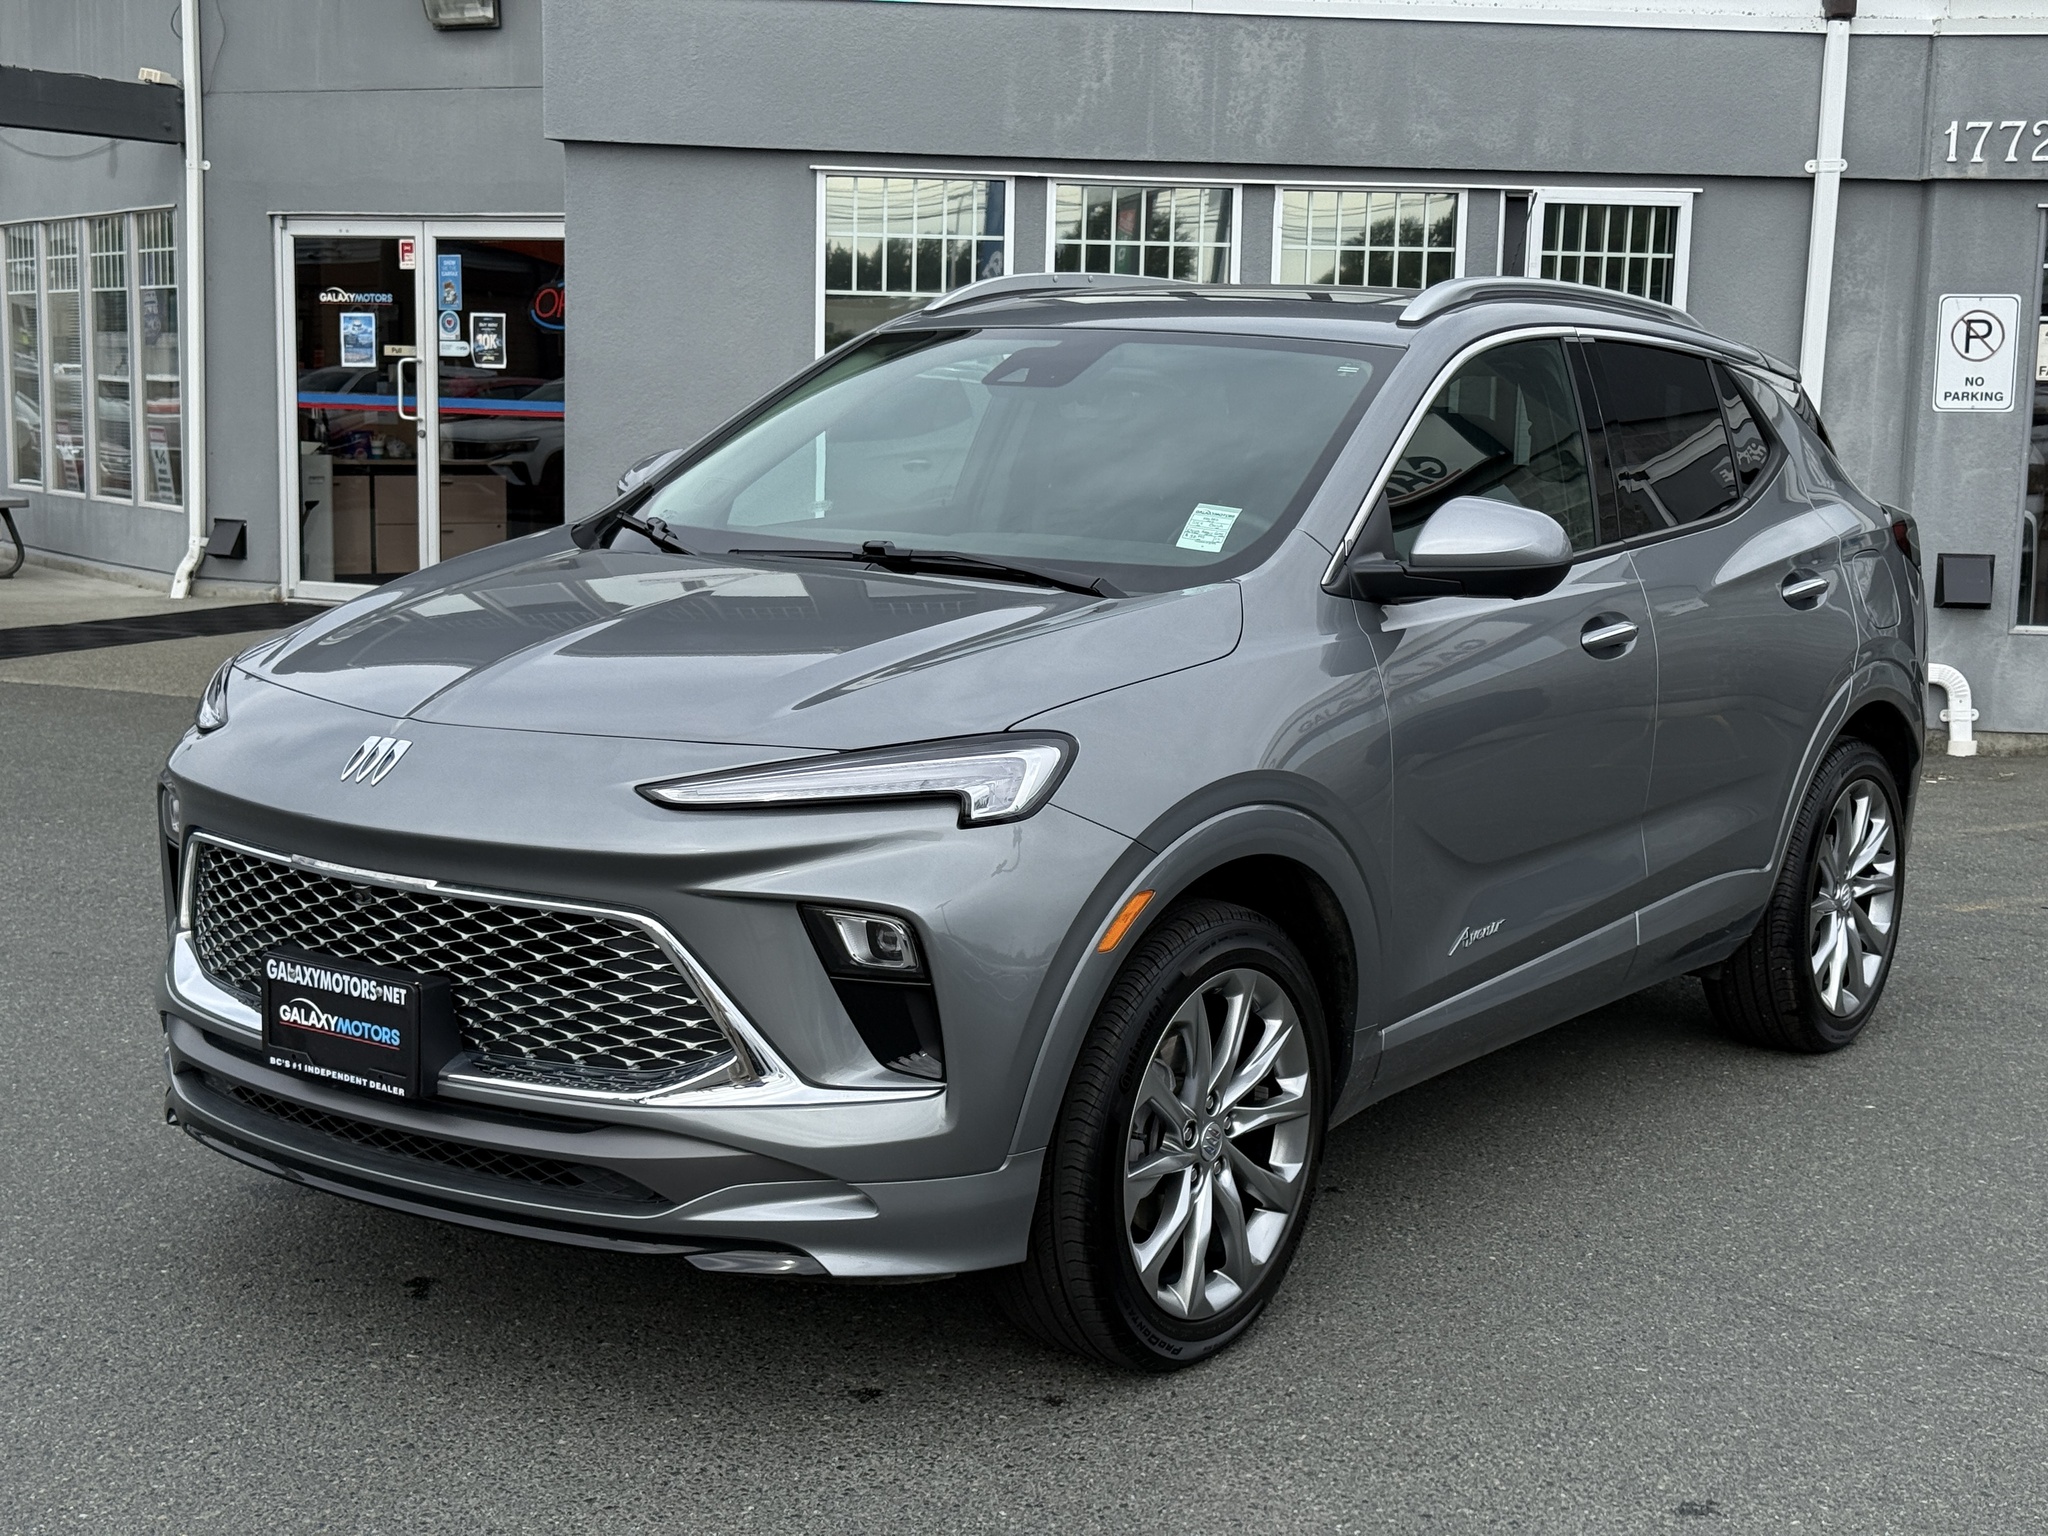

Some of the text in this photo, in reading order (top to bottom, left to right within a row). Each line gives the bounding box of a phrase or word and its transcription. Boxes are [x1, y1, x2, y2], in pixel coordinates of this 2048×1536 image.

[1964, 376, 1985, 388] NO
[1943, 391, 2004, 402] PARKING
[269, 1056, 405, 1097] BC'S #1 INDEPENDENT DEALER
